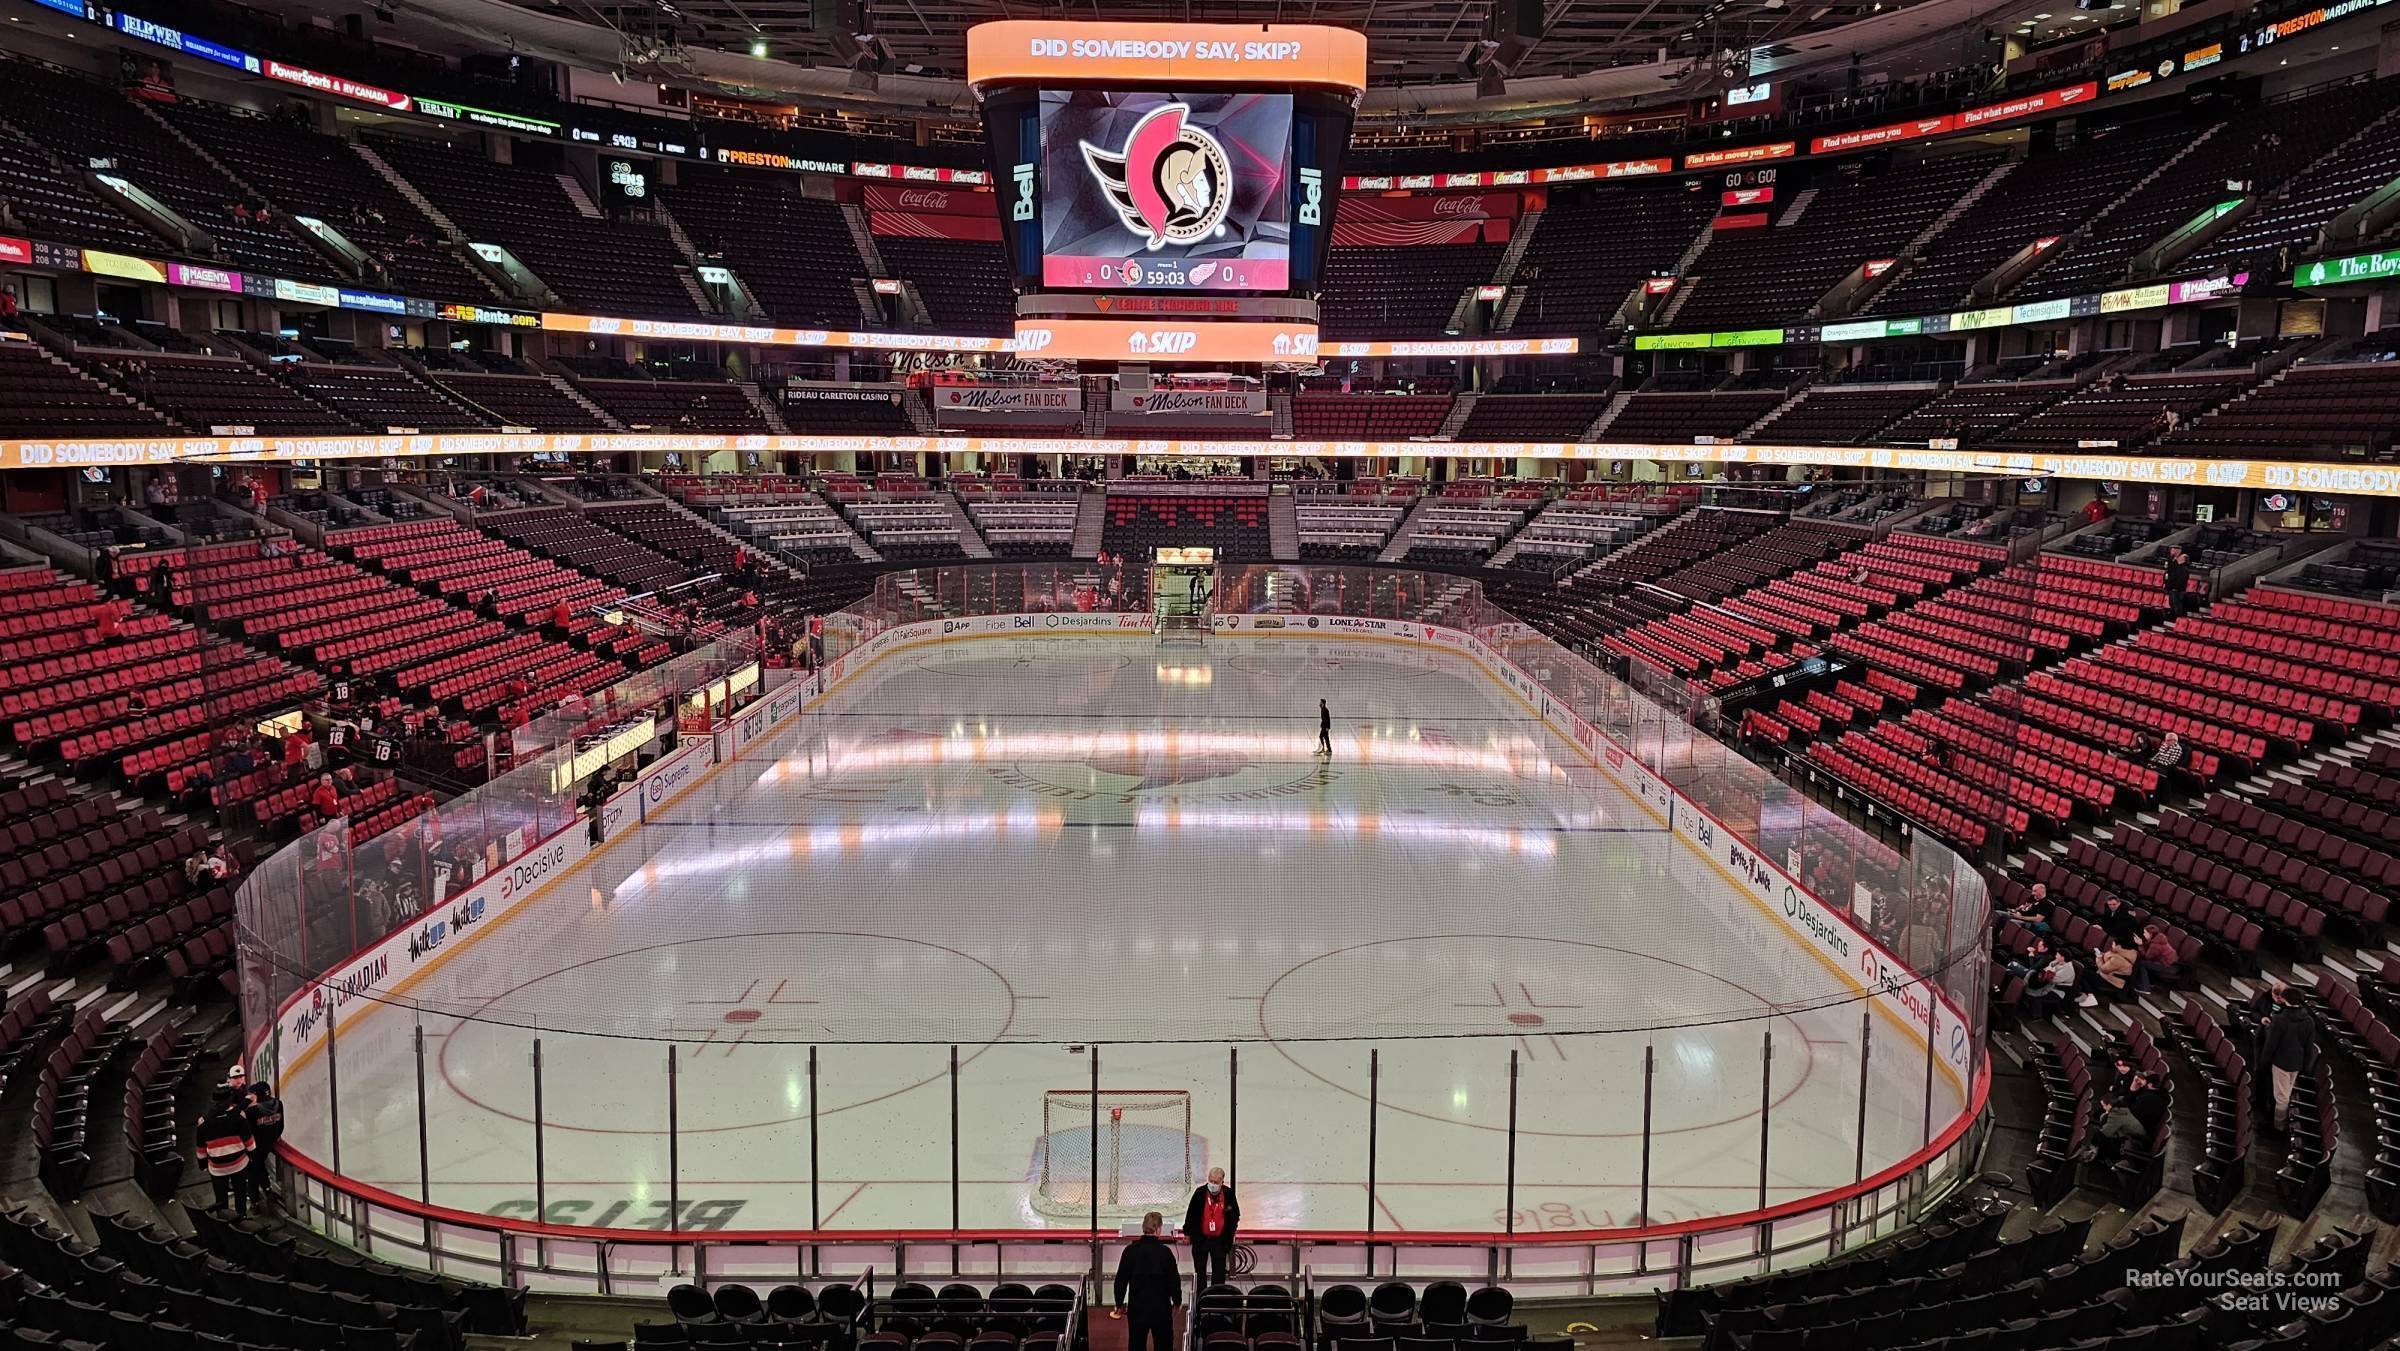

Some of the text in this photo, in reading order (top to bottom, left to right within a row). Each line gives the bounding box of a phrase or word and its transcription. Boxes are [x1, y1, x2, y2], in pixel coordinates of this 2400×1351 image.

[1031, 39, 1300, 62] DID SOMEBODY SAY, SKIP?
[333, 81, 341, 92] &
[344, 83, 354, 94] RV
[354, 86, 388, 104] CANADA
[1964, 98, 2044, 123] Find what moves you
[1822, 126, 1902, 148] Find what moves you
[1686, 148, 1764, 165] Find what moves you
[1546, 168, 1562, 182] Tim
[1606, 164, 1624, 176] Tim
[1726, 169, 1776, 187] GO GO!
[612, 172, 644, 188] SENS
[900, 190, 950, 208] Coca-Cola
[1014, 163, 1034, 222] Bell
[1300, 168, 1322, 226] Bell
[1433, 196, 1484, 214] Coca-Cola
[1100, 264, 1112, 280] 0
[1222, 266, 1234, 282] 0
[2339, 257, 2368, 276] The
[190, 268, 230, 284] MAGENTA
[1148, 272, 1185, 286] 59:03
[1240, 274, 1244, 282] 0
[2102, 292, 2132, 310] RE/MAX
[2134, 286, 2168, 299] Hallmark
[1959, 311, 1986, 329] MNP
[849, 334, 932, 348] DID SOMEBODY
[1151, 331, 1197, 353] SKIP
[1392, 344, 1473, 354] DID SOMEBODY
[885, 352, 964, 373] Molson
[788, 390, 889, 401] RIDEAU CARLETON CASINO
[963, 390, 1067, 408] Molson FAN DECK
[1147, 392, 1248, 412] Molson FAN DECK
[296, 440, 354, 457] SOMEBODY
[610, 438, 670, 450] SOMEBODY
[780, 438, 866, 450] DID SOMEBODY
[1596, 447, 1658, 458] SOMEBODY
[20, 443, 53, 464] DID
[55, 443, 146, 464] SOMEBODY
[1774, 450, 1826, 462] SOMEBODY
[1912, 452, 1956, 467] SOMEBODY
[2063, 459, 2197, 480] SOMEBODY SKIP?
[2264, 466, 2400, 492] DID SOMEBODY
[985, 616, 1035, 630] Fibe Bell
[1062, 616, 1112, 628] Desjardins
[1118, 615, 1136, 628] Tim
[1364, 620, 1386, 629] STAR
[900, 626, 932, 640] FairSquare
[336, 687, 348, 700] 18
[329, 730, 344, 745] 18
[376, 745, 390, 760] 18
[664, 764, 690, 789] Supreme
[1680, 806, 1714, 850] Fibe Bell
[514, 845, 564, 892] Decisive
[1798, 900, 1848, 958] Desjardins
[336, 952, 388, 1008] CANADIAN
[1880, 964, 1941, 1037] FairSquae
